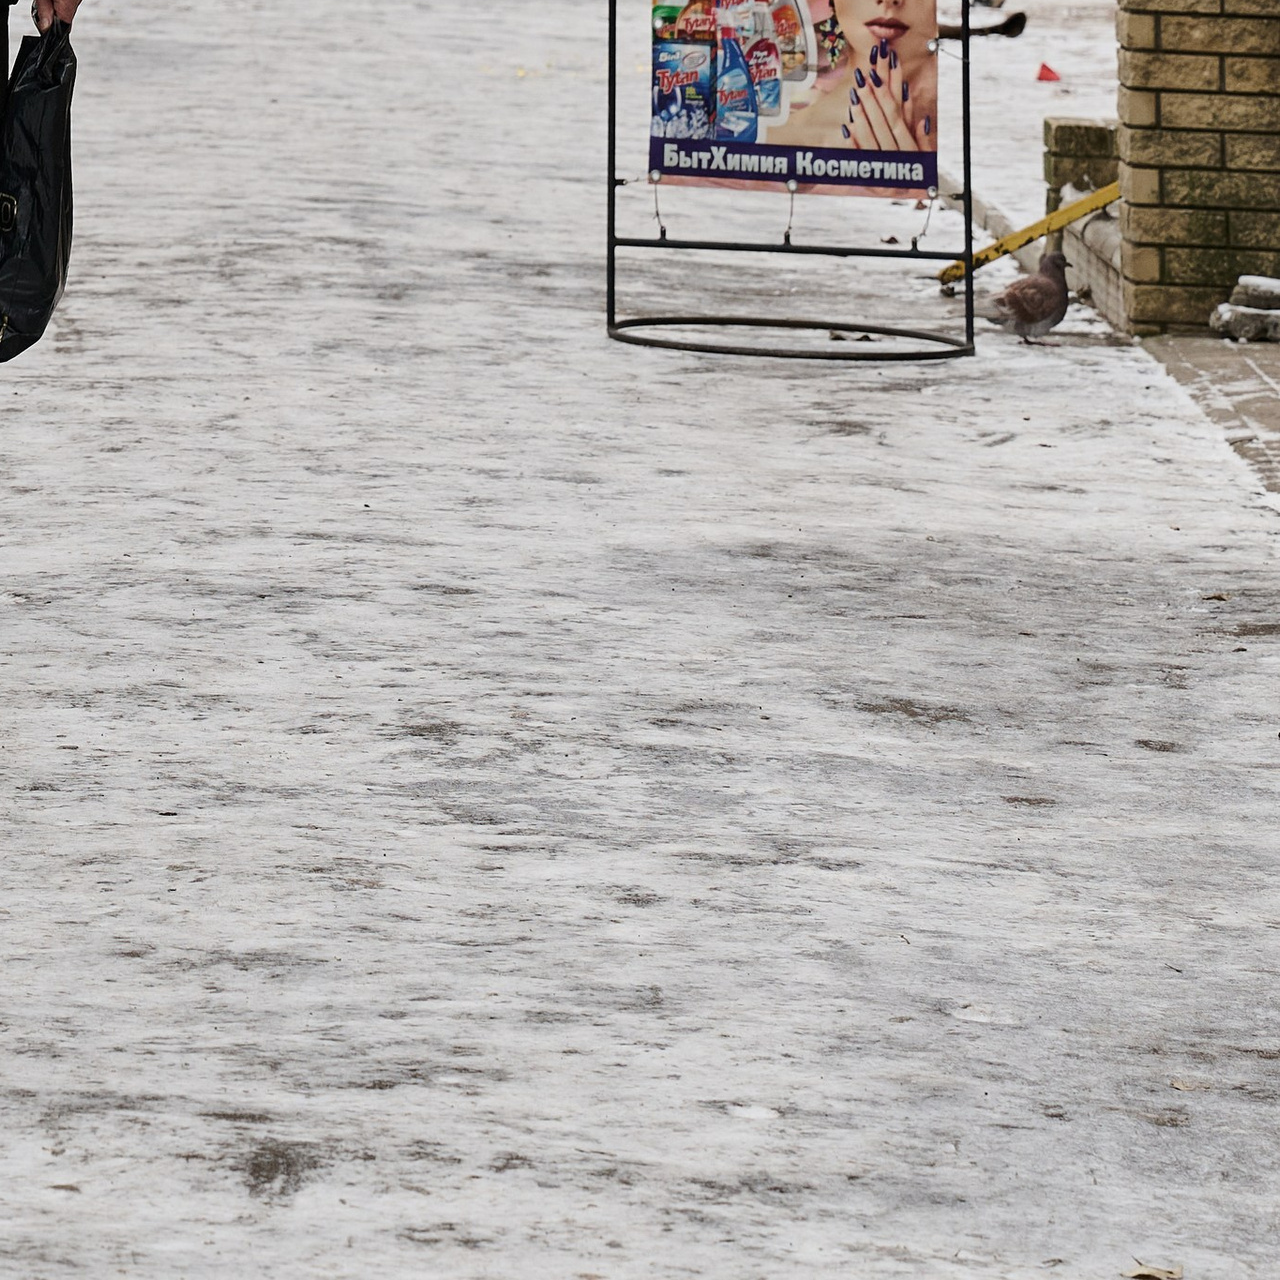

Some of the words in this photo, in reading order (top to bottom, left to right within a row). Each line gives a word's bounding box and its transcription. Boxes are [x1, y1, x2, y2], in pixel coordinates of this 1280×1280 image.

[655, 68, 700, 95] Tytan
[663, 143, 788, 174] БытХимия
[796, 150, 924, 181] Косметика
